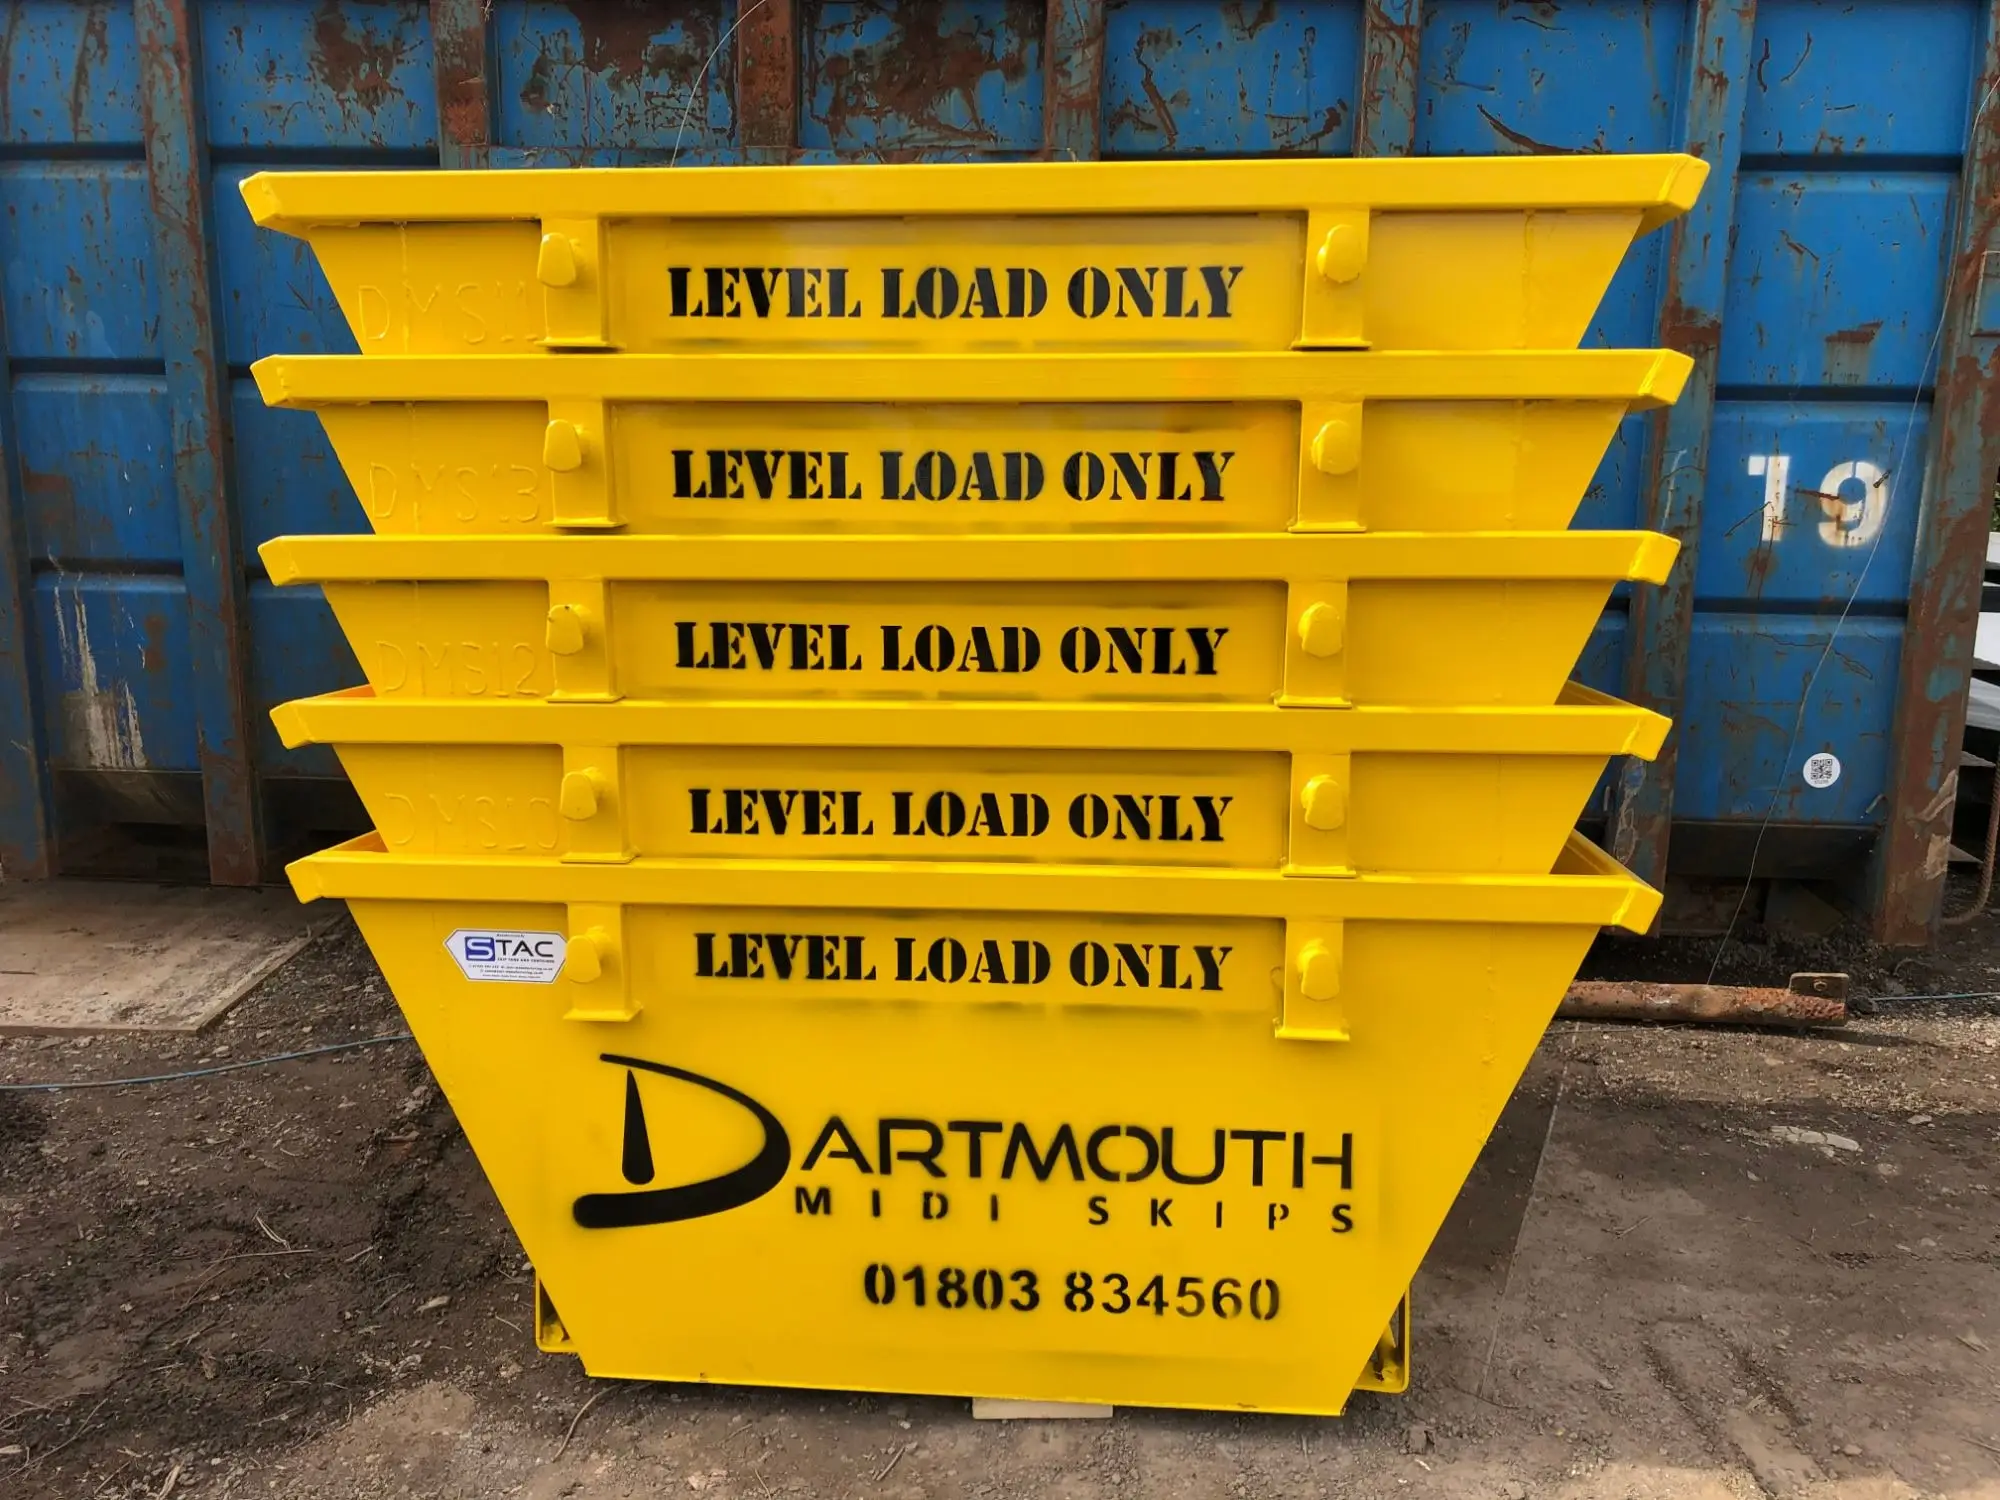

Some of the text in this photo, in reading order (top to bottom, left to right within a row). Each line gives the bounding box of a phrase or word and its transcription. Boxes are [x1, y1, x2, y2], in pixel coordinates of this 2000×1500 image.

[668, 267, 1242, 318] LEVEL LOAD ONLY
[672, 450, 1234, 500] LEVEL LOAD ONLY
[1747, 455, 1887, 547] 19
[375, 640, 541, 697] DMS12
[675, 622, 1228, 675] LEVEL LOAD ONLY
[689, 789, 1232, 841] LEVEL LOAD ONLY
[464, 936, 554, 961] STAC
[696, 933, 1232, 990] LEVEL LOAD ONLY
[573, 1053, 1353, 1230] DARTMOUTH
[795, 1186, 1353, 1233] MIDI SKIPS
[864, 1263, 1279, 1320] 01803 834560
